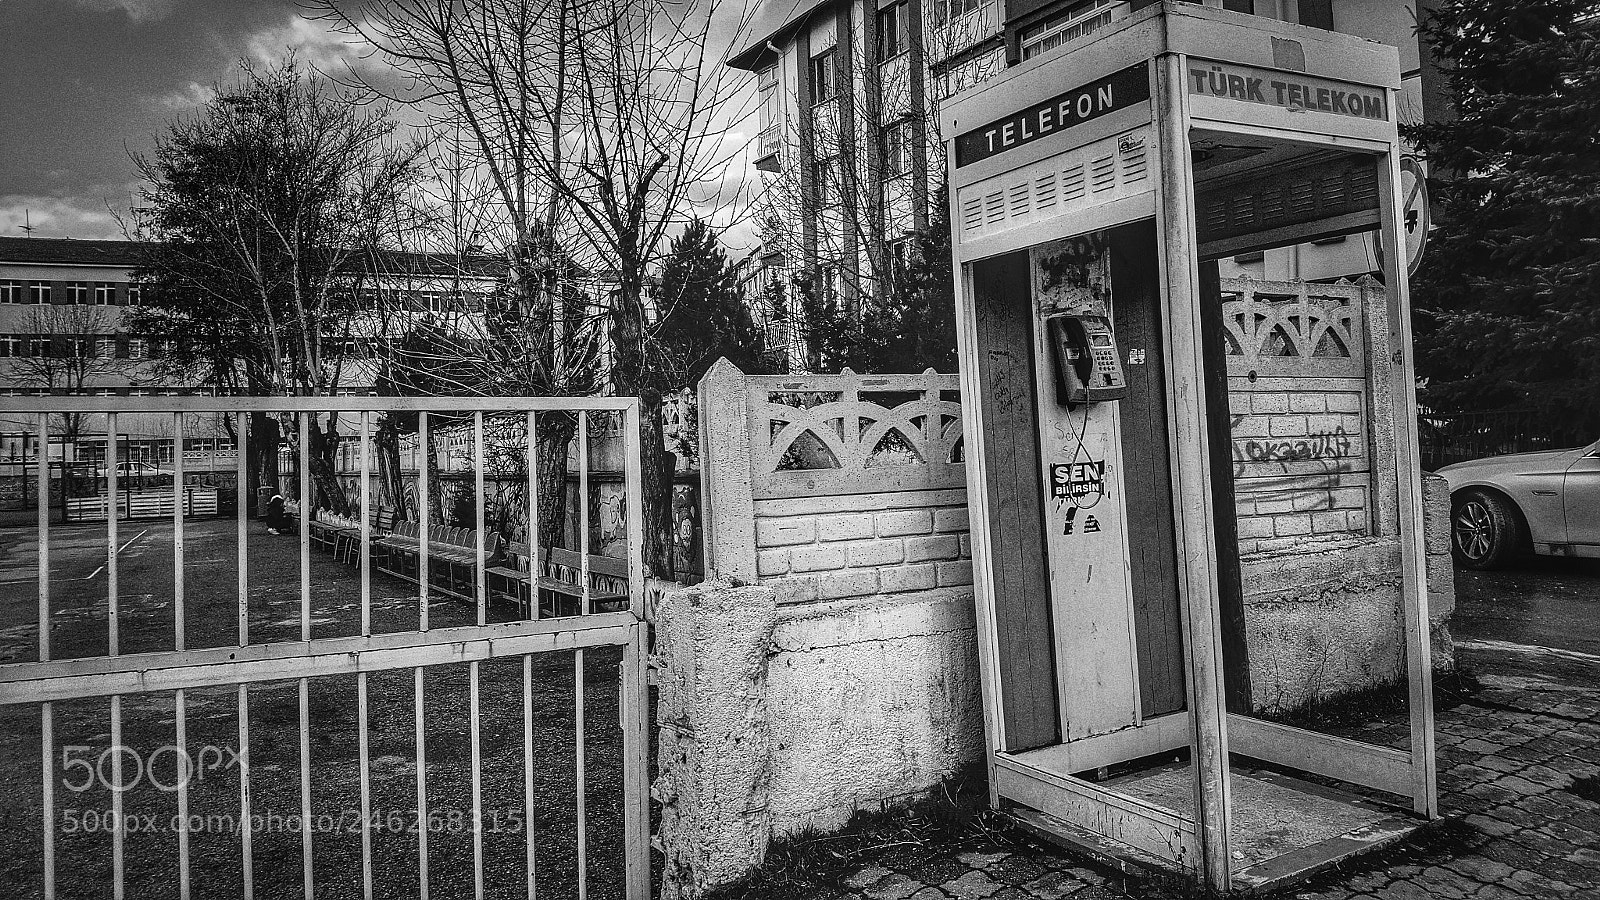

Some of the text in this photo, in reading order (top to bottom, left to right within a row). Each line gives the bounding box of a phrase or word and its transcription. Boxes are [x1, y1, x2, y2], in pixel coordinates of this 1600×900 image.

[985, 84, 1114, 153] TELEFON
[1190, 66, 1382, 119] TÜRK TELEKOM
[1055, 465, 1099, 483] SEN
